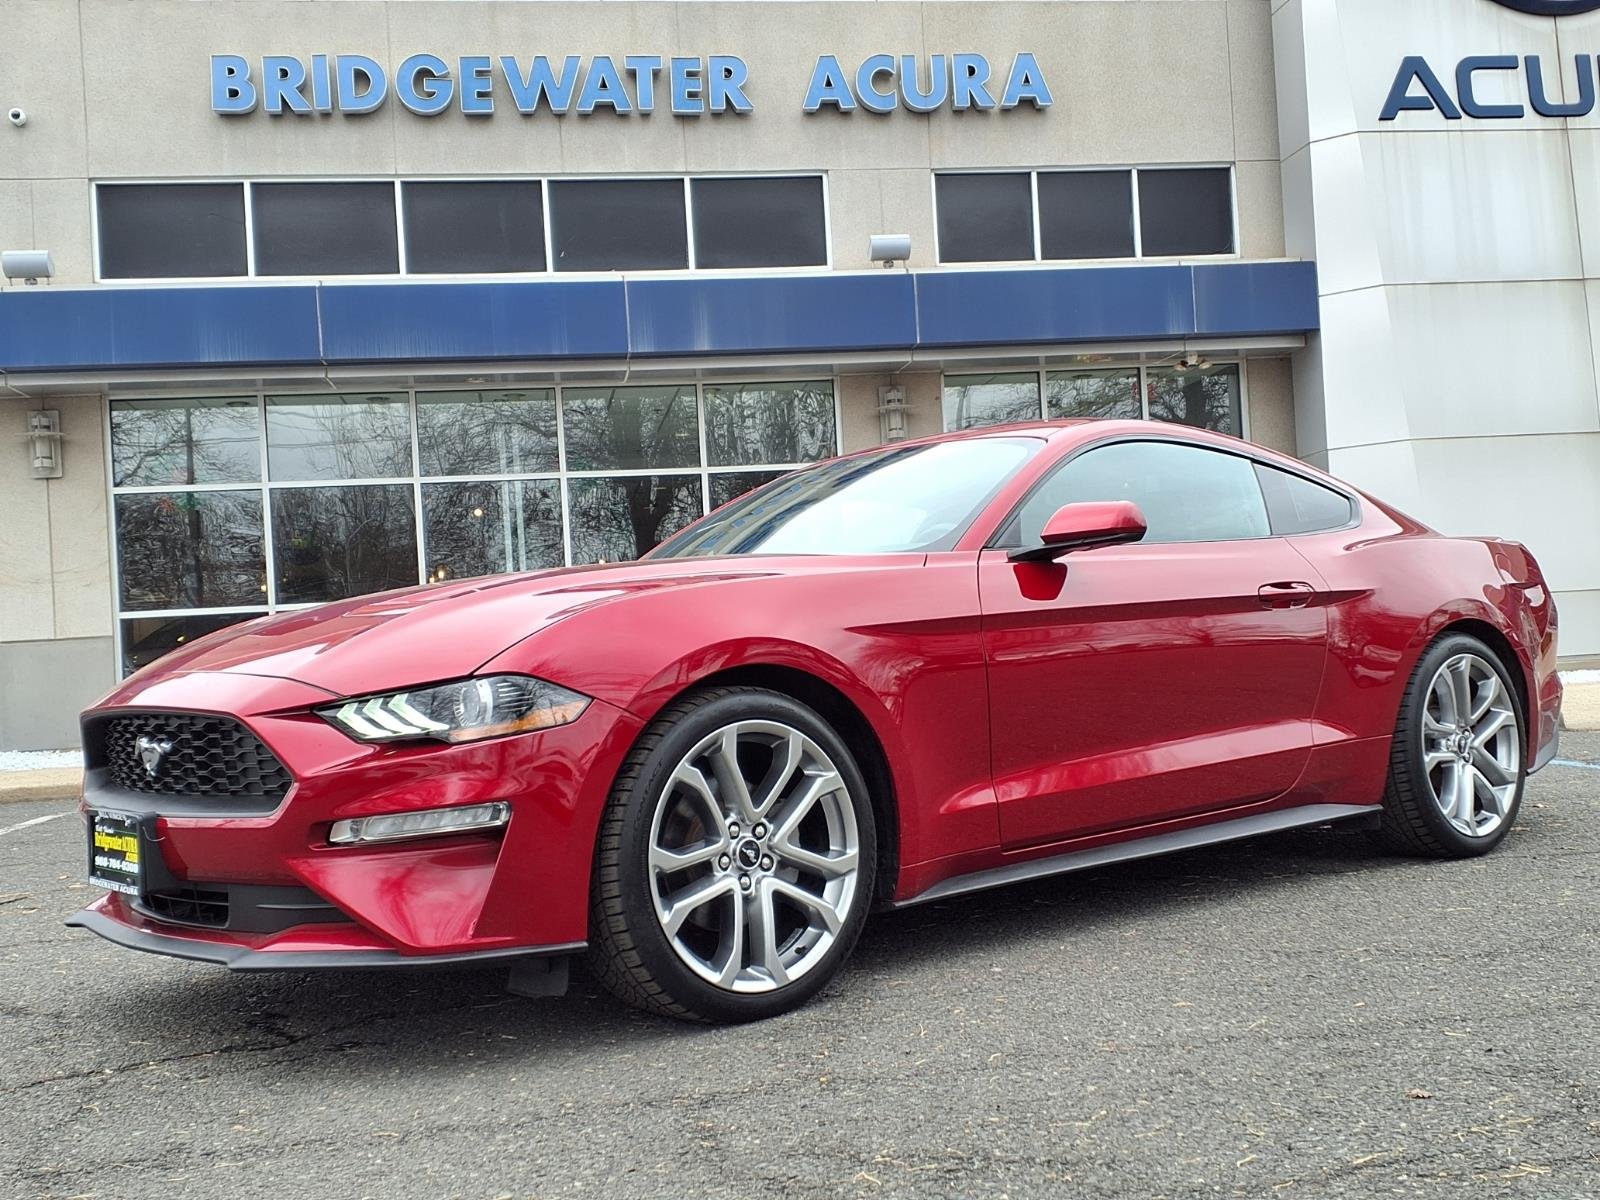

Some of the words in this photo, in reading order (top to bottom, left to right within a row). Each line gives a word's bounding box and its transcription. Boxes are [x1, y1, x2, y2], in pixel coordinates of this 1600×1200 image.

[210, 53, 754, 116] BRIDGEWATER
[802, 52, 1055, 114] ACURA
[1378, 54, 1600, 121] ACU
[120, 885, 138, 896] ACURA
